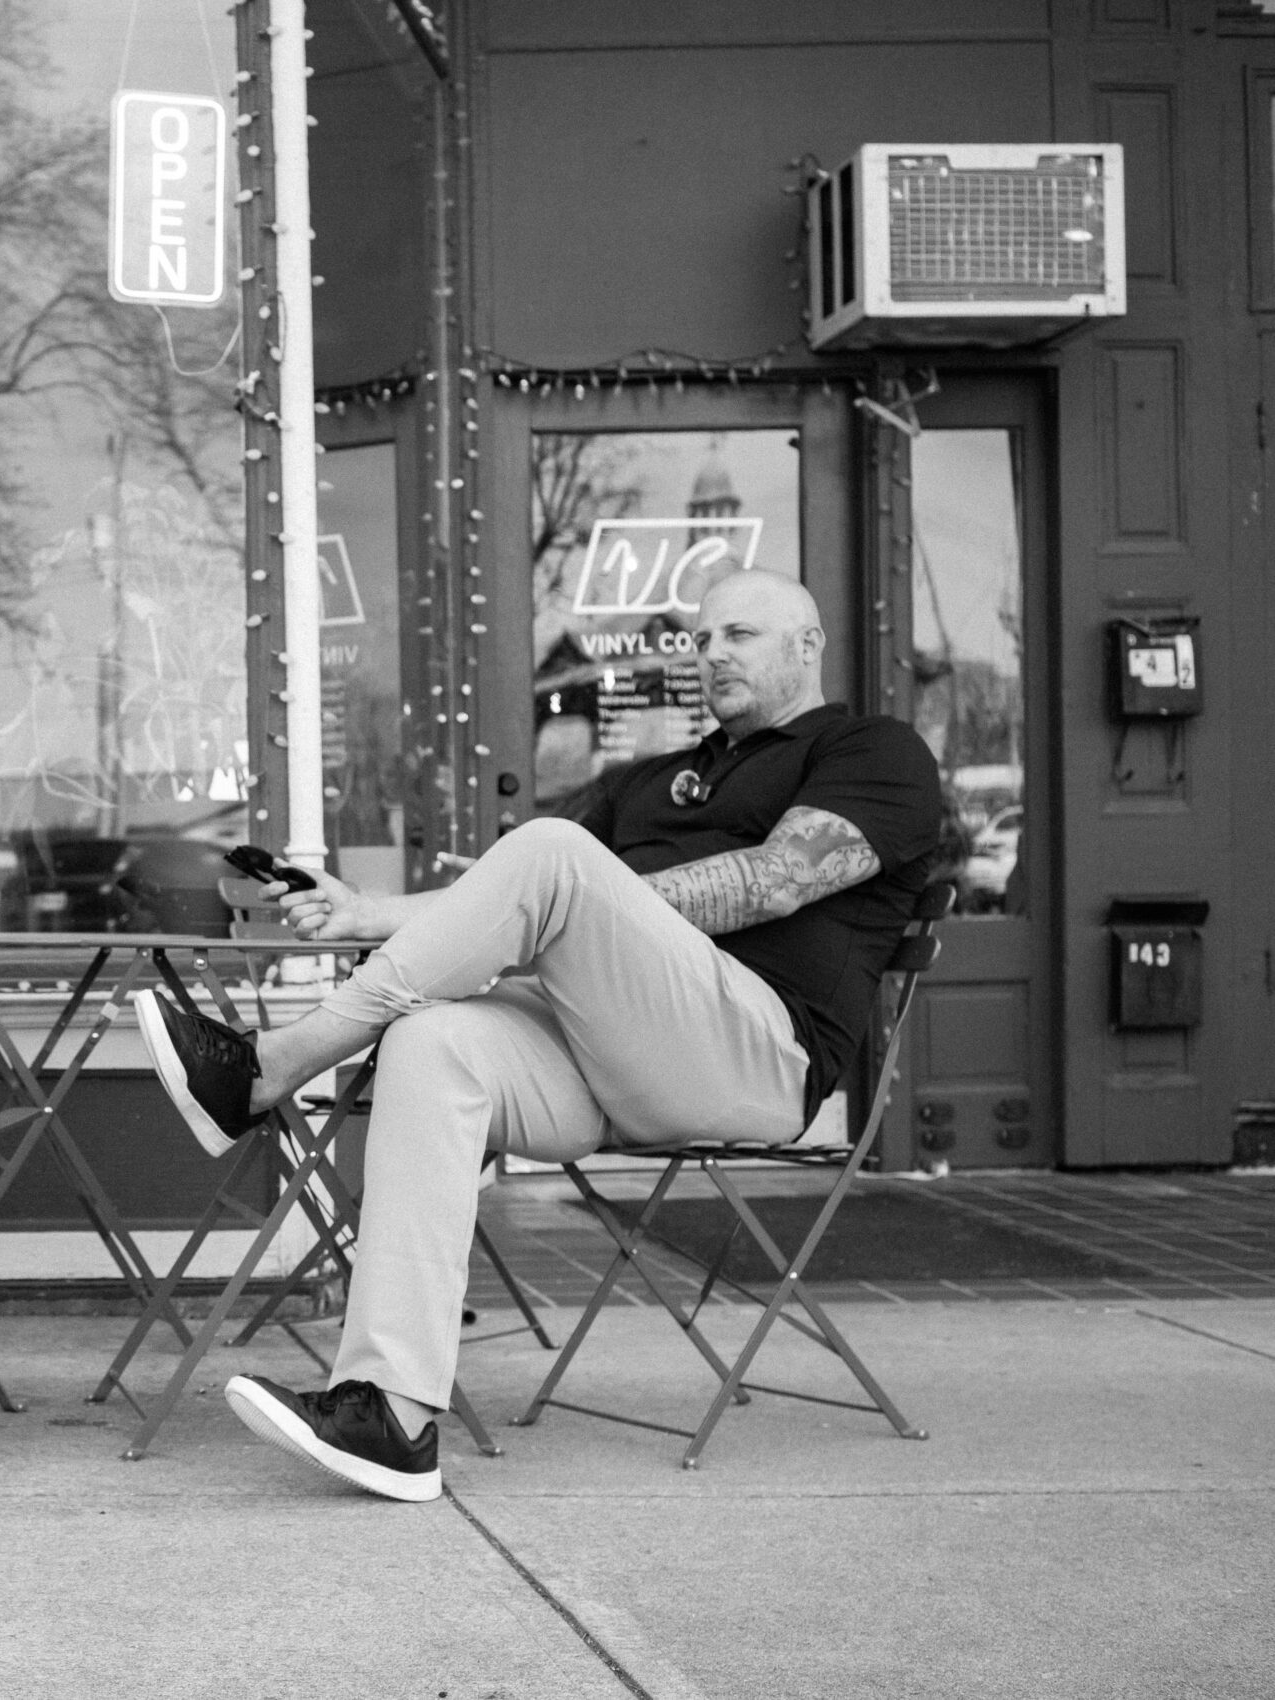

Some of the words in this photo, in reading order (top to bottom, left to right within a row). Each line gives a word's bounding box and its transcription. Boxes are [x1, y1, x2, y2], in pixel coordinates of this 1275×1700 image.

[149, 107, 189, 291] OPEN
[580, 632, 653, 655] VINYL
[1129, 942, 1170, 967] 143
